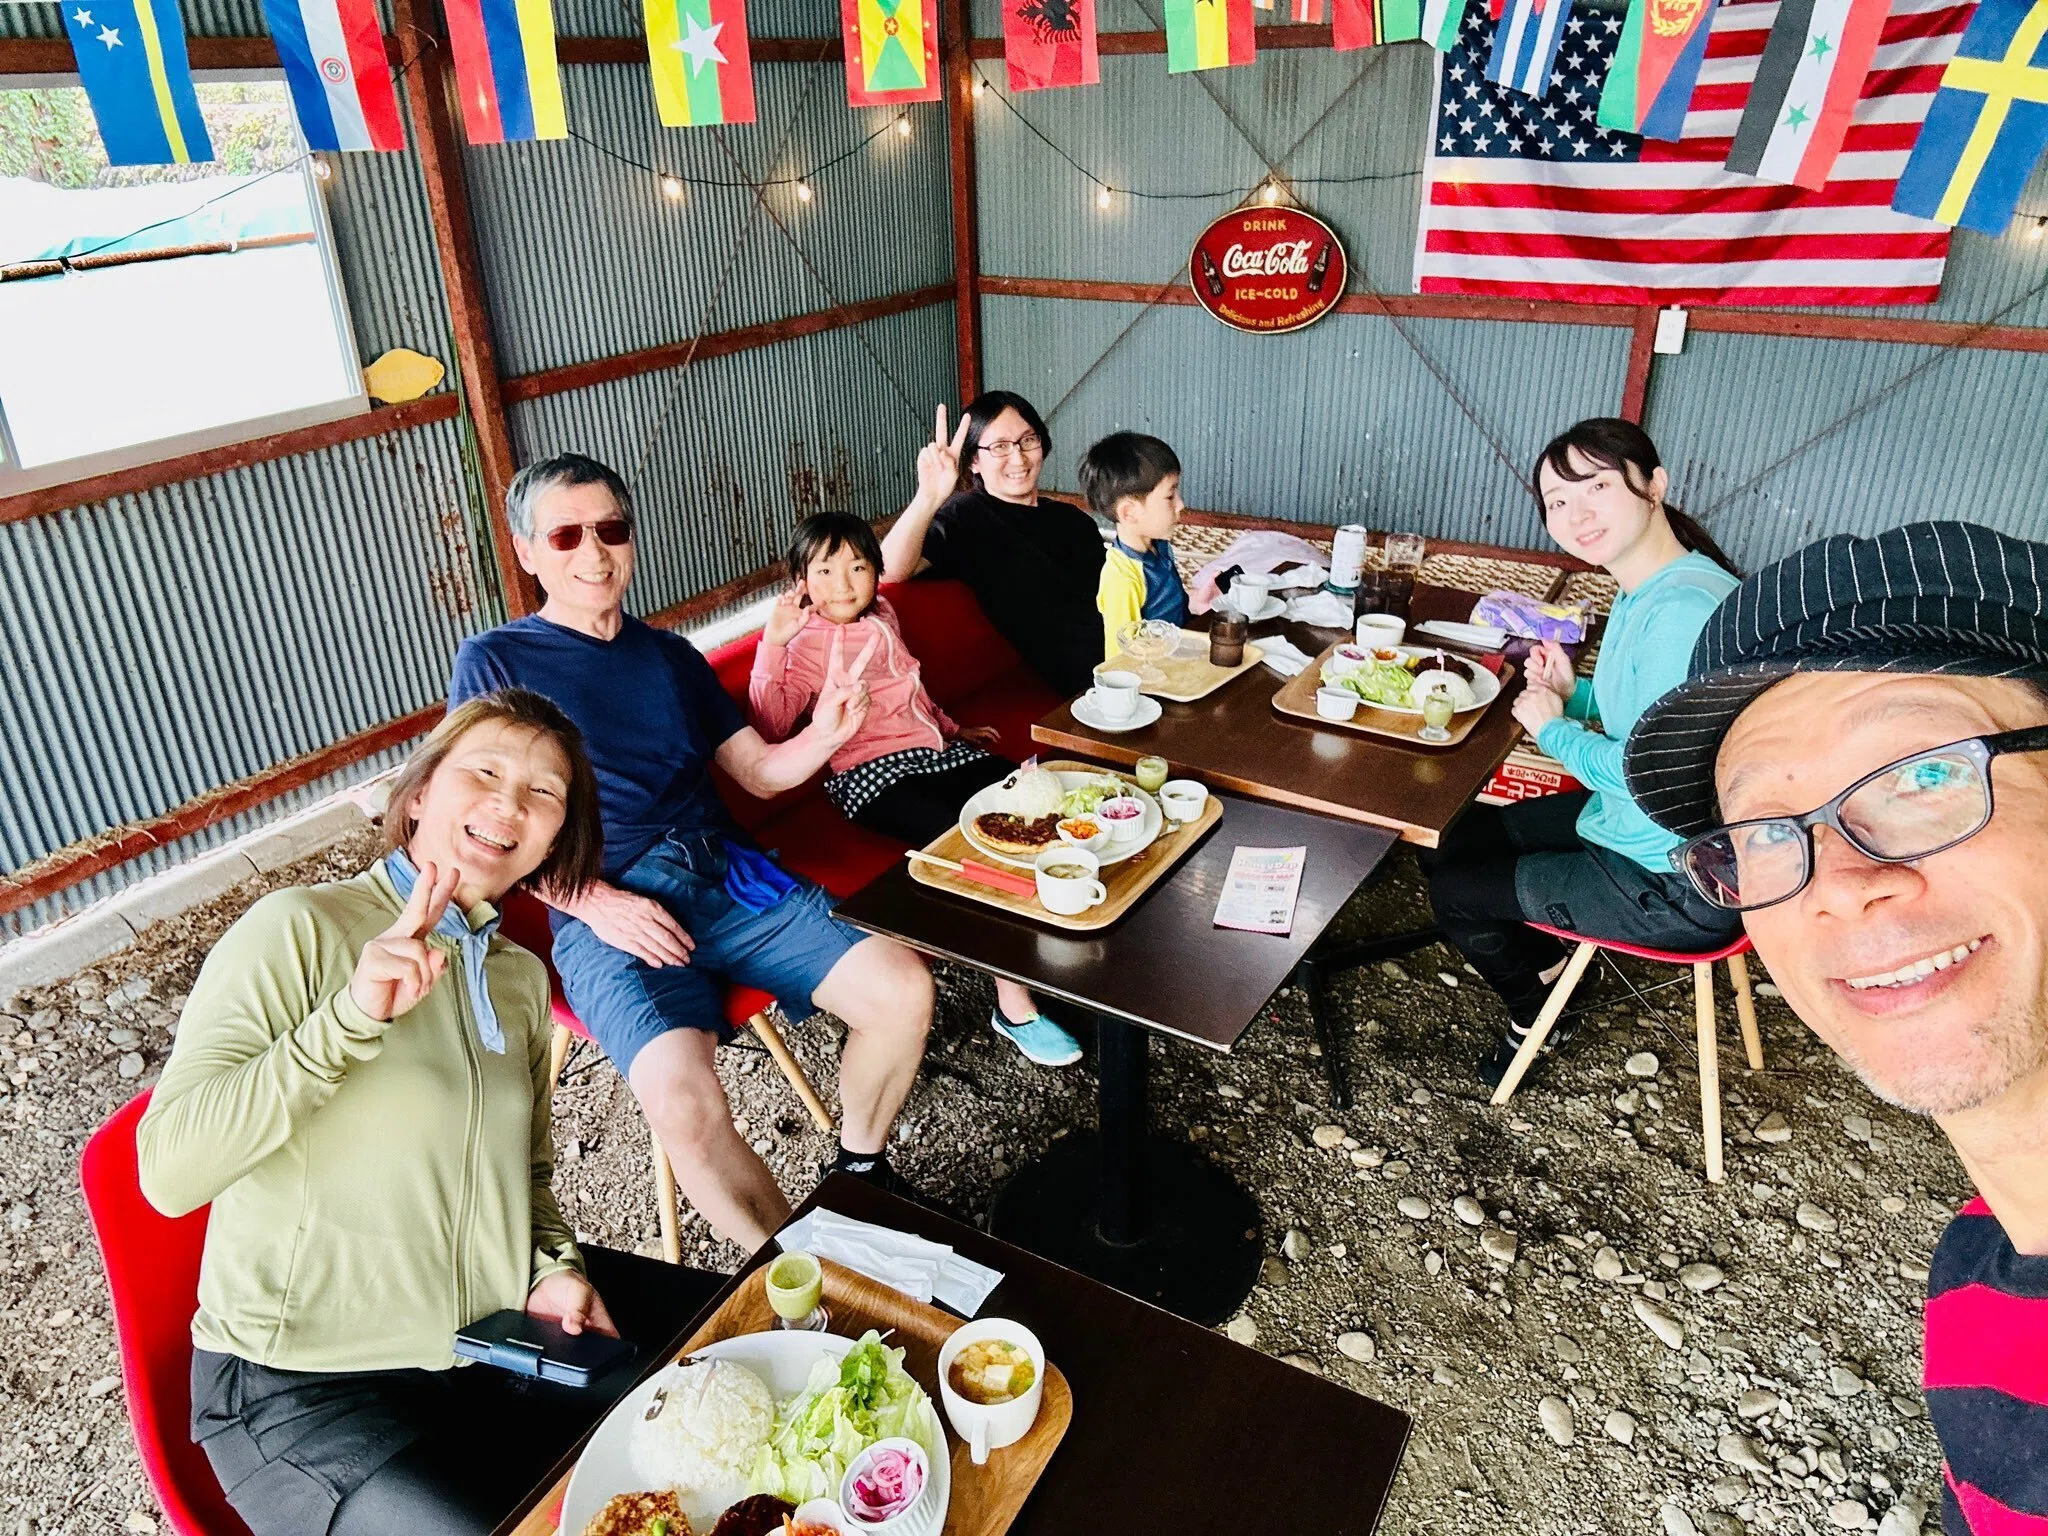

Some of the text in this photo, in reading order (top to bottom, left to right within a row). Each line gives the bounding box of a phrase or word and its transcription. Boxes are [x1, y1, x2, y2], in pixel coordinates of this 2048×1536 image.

[1243, 220, 1287, 232] DRINK
[1222, 239, 1313, 278] Coca-Cola
[1235, 287, 1299, 301] ICE-COLD
[1218, 299, 1326, 328] Delicious and Refreshing
